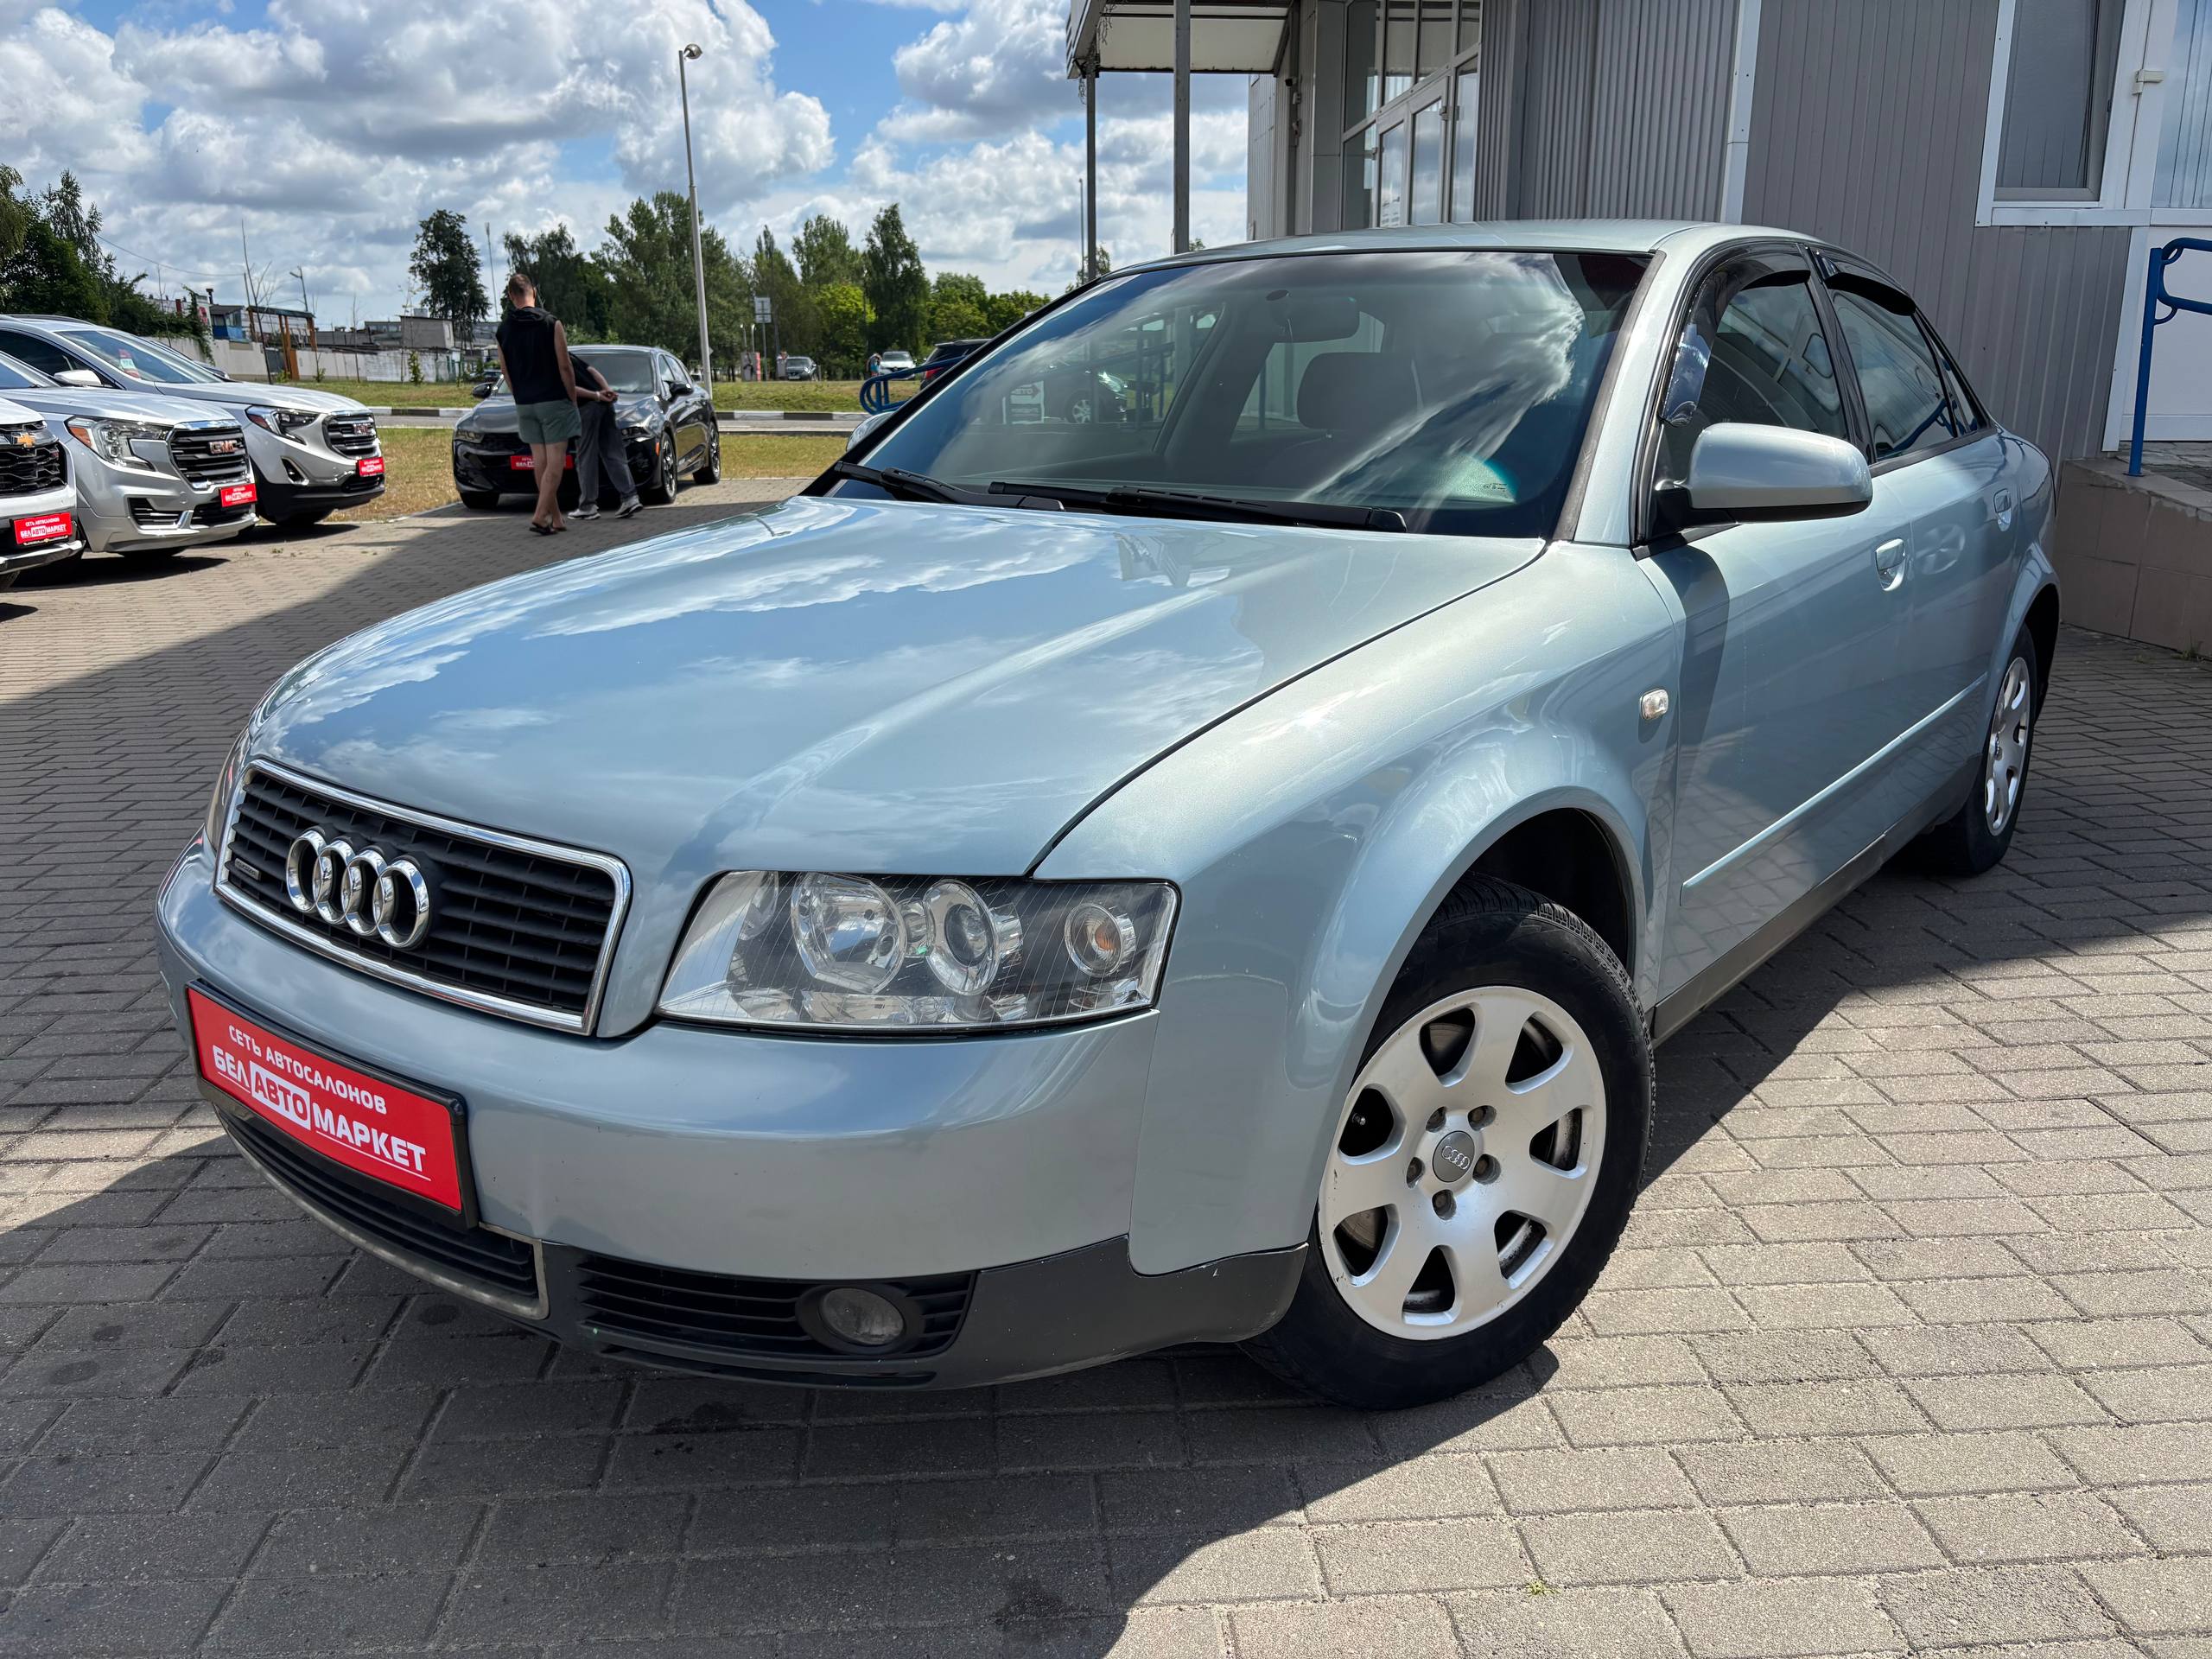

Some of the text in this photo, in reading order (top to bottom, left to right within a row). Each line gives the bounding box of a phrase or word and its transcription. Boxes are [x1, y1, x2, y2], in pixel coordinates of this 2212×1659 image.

[209, 440, 238, 454] GMC
[228, 1025, 387, 1115] СЕТЬ АВТОСАЛОНОВ
